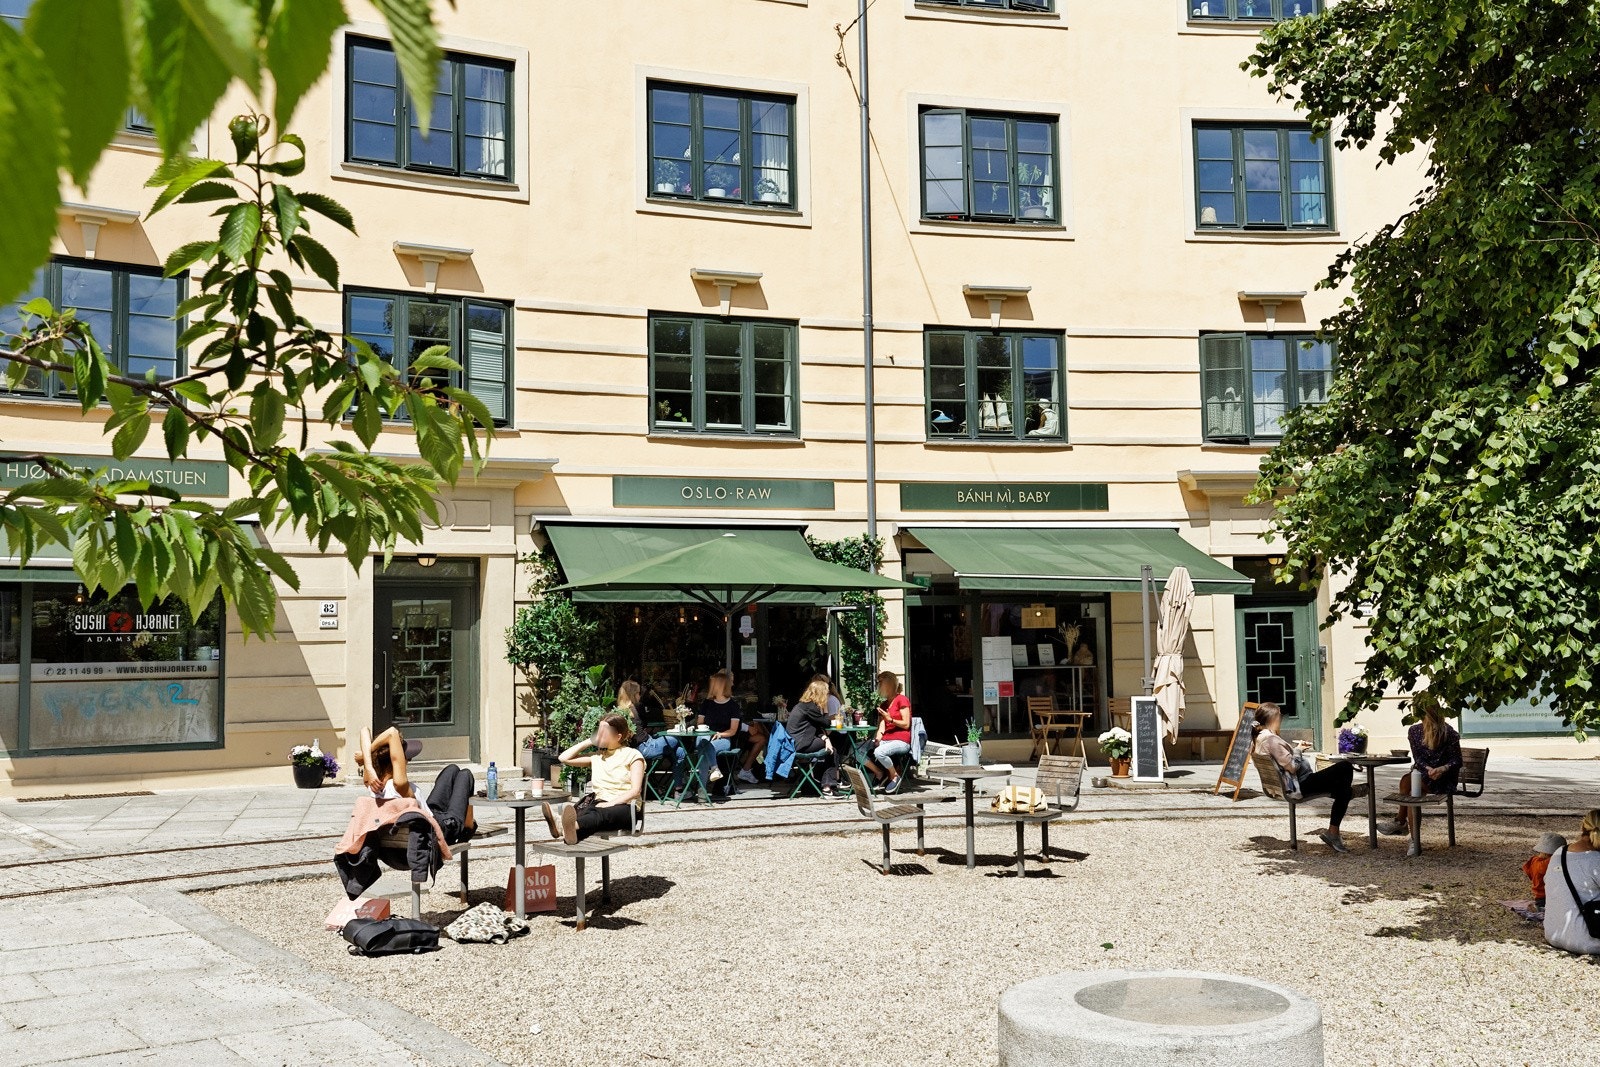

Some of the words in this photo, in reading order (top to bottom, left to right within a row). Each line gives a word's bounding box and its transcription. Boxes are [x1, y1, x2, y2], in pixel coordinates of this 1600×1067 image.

[98, 467, 206, 485] ADAMSTUEN
[957, 488, 993, 503] BÁNH
[1018, 491, 1051, 503] BABY
[323, 603, 335, 613] 82
[74, 614, 106, 630] SUSHI
[135, 614, 181, 630] HJØRNET
[86, 635, 168, 643] ADAMSTUEN
[56, 667, 67, 676] 22
[69, 667, 78, 675] 11
[81, 667, 92, 675] 49
[93, 667, 104, 675] 99
[525, 871, 550, 887] slo
[525, 888, 550, 900] aw
